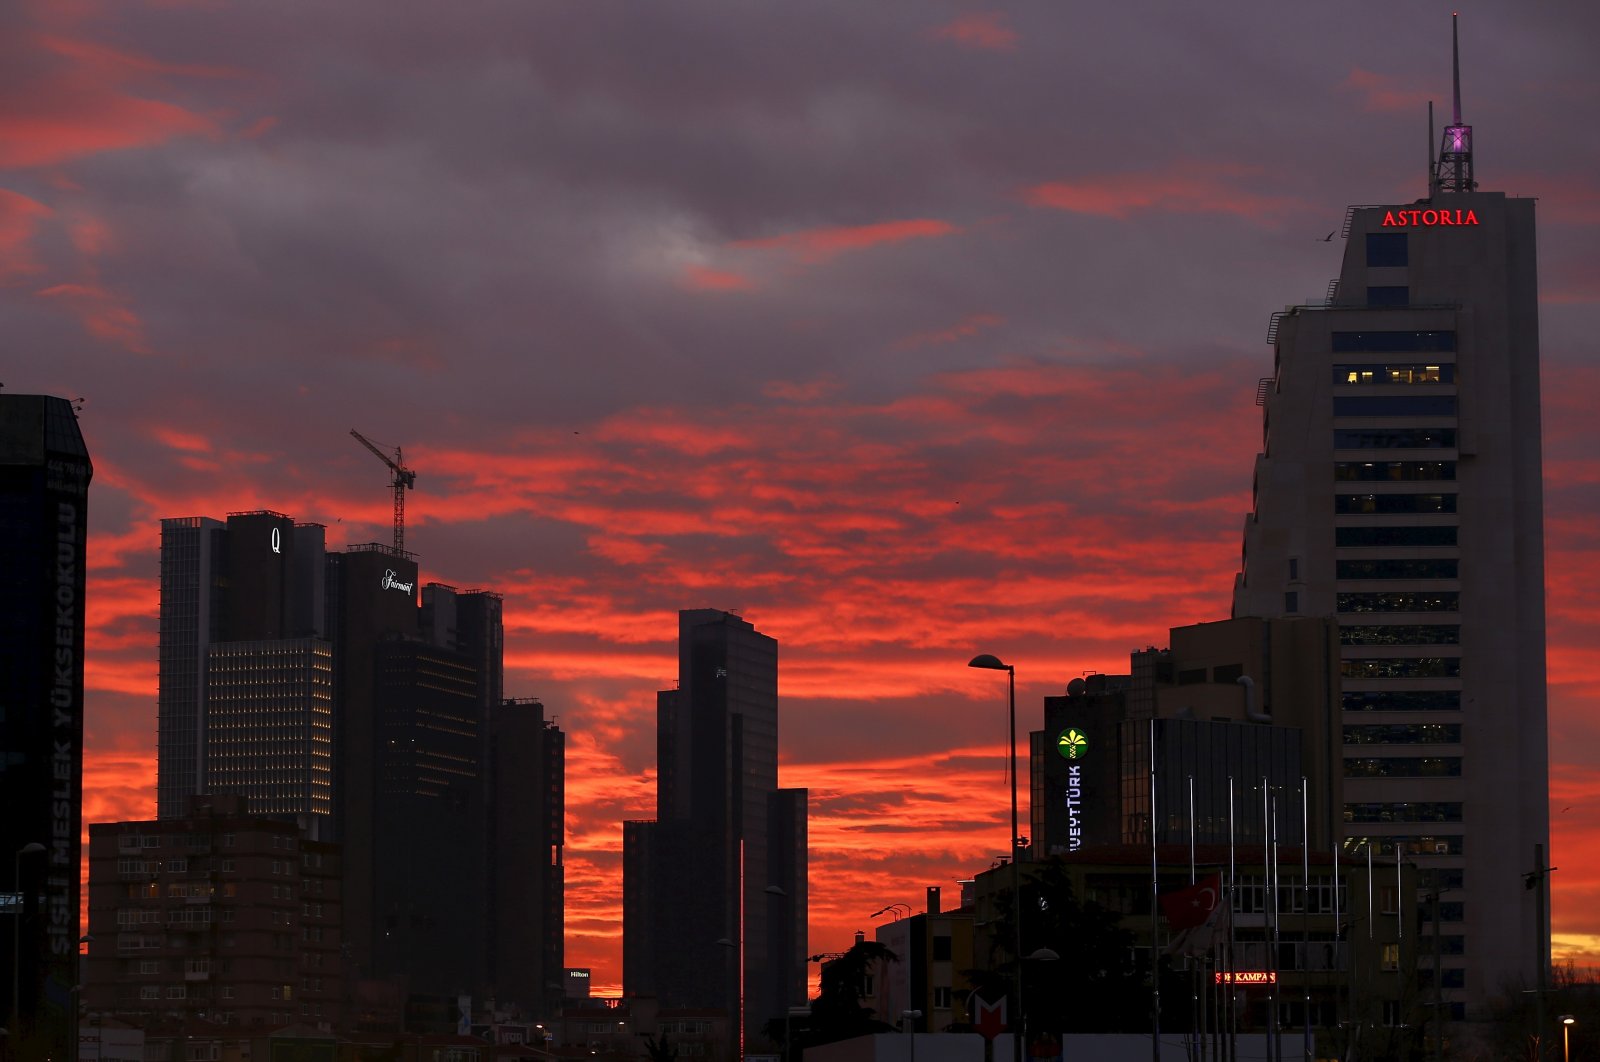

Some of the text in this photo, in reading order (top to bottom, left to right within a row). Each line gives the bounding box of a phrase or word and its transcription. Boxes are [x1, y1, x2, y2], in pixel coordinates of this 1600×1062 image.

[1382, 209, 1480, 226] ASTORIA
[271, 527, 281, 553] Q
[49, 501, 76, 729] YÜKSEKOKULU
[50, 737, 72, 866] MESLEK
